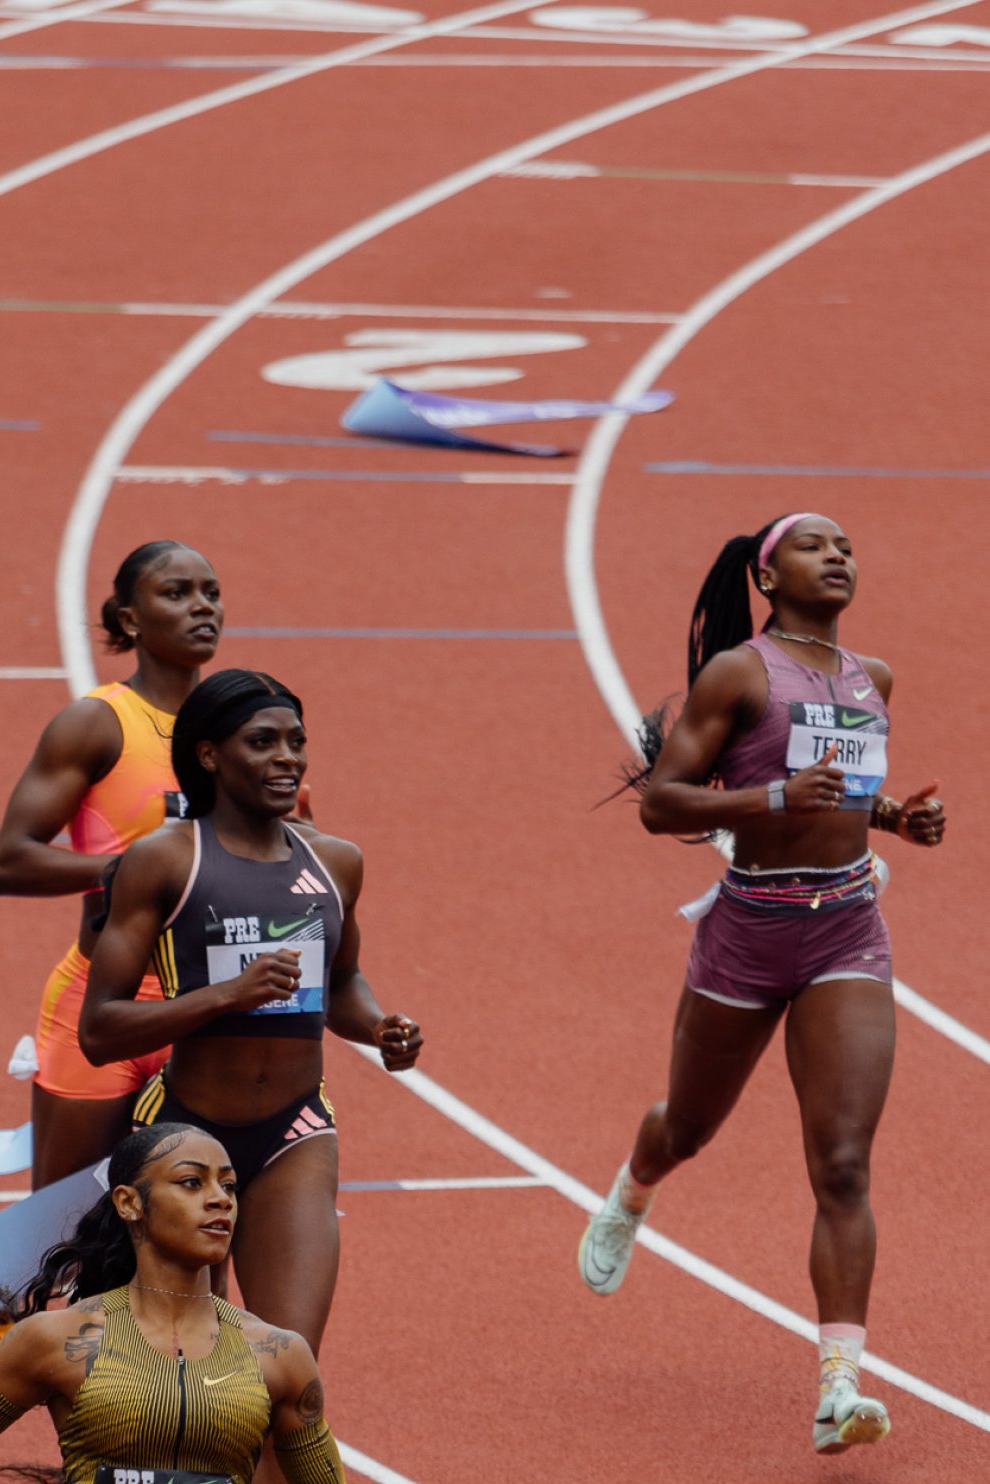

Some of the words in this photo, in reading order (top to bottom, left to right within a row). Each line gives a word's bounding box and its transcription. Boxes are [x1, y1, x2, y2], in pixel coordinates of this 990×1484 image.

[262, 329, 588, 390] 2
[804, 702, 836, 729] PRE
[812, 735, 867, 766] TERRY
[223, 917, 261, 944] PRE
